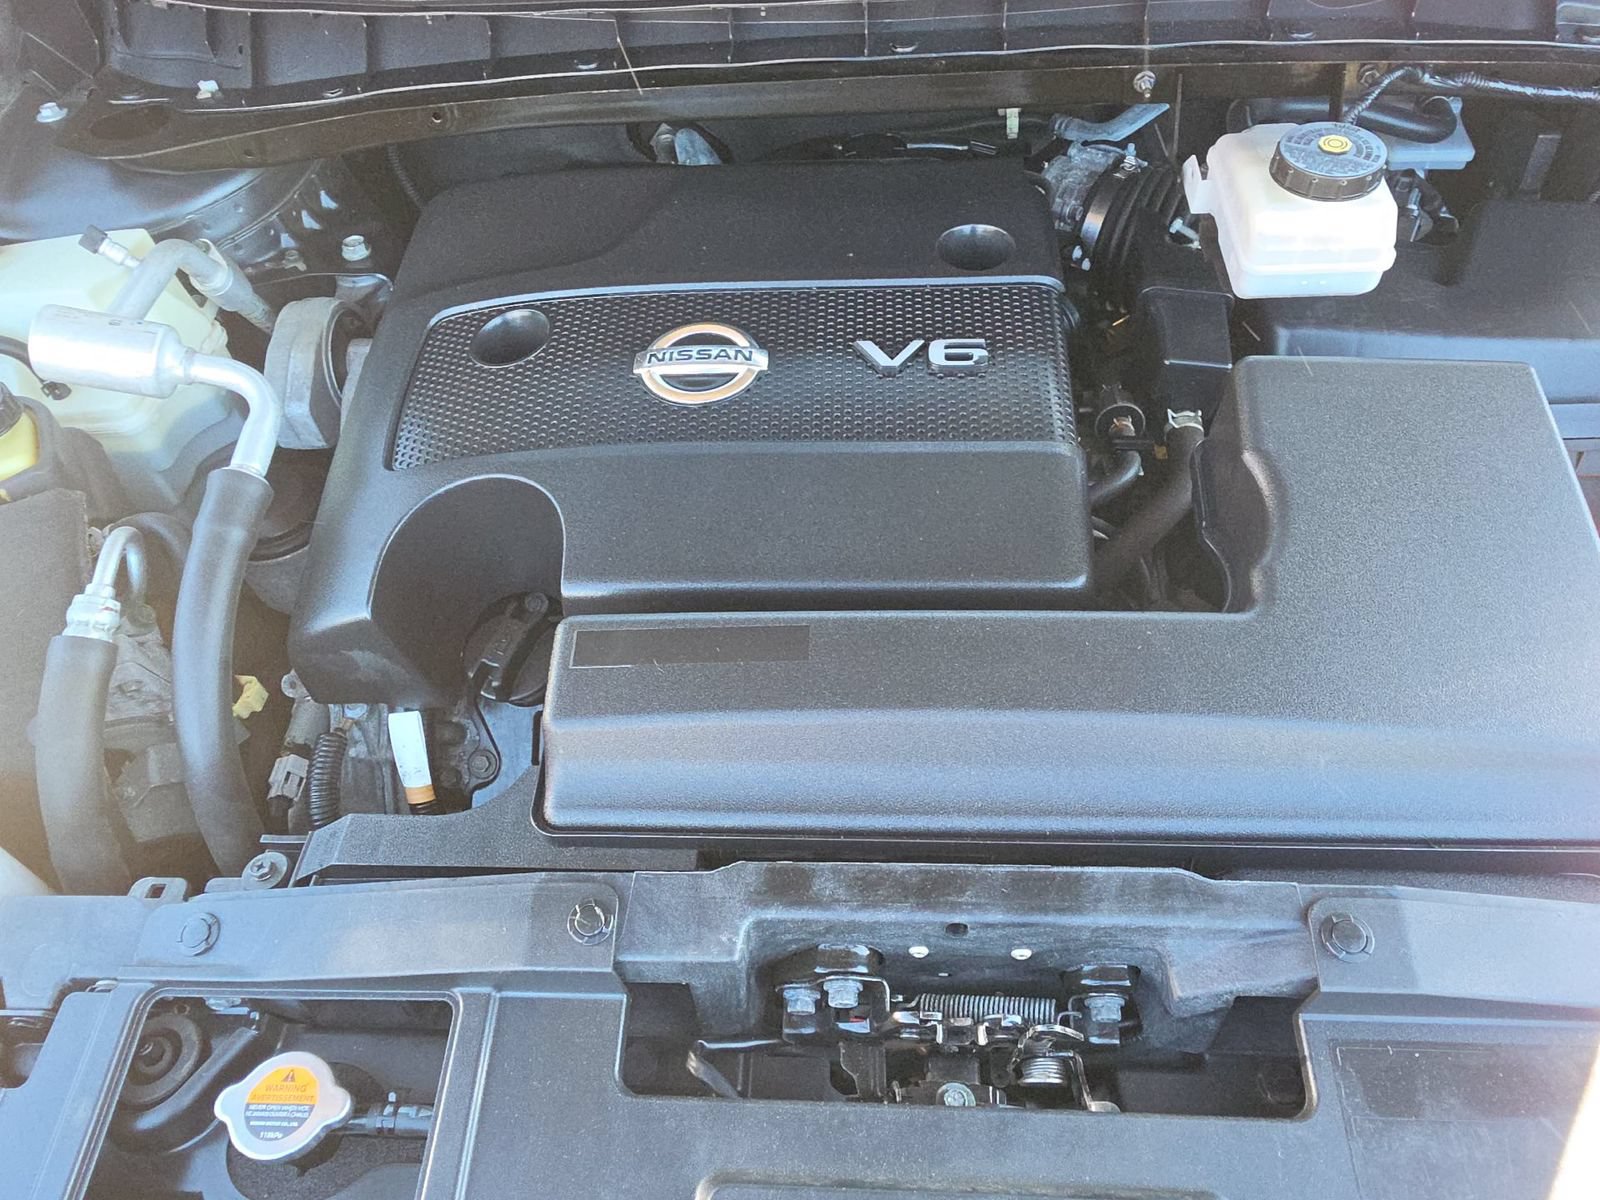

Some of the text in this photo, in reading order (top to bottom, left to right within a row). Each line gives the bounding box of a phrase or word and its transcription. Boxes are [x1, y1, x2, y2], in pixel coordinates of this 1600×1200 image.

[646, 348, 754, 366] NISSAN
[853, 338, 990, 376] V6
[265, 1083, 307, 1093] WARNING
[250, 1094, 315, 1103] AVERTISSEMENT
